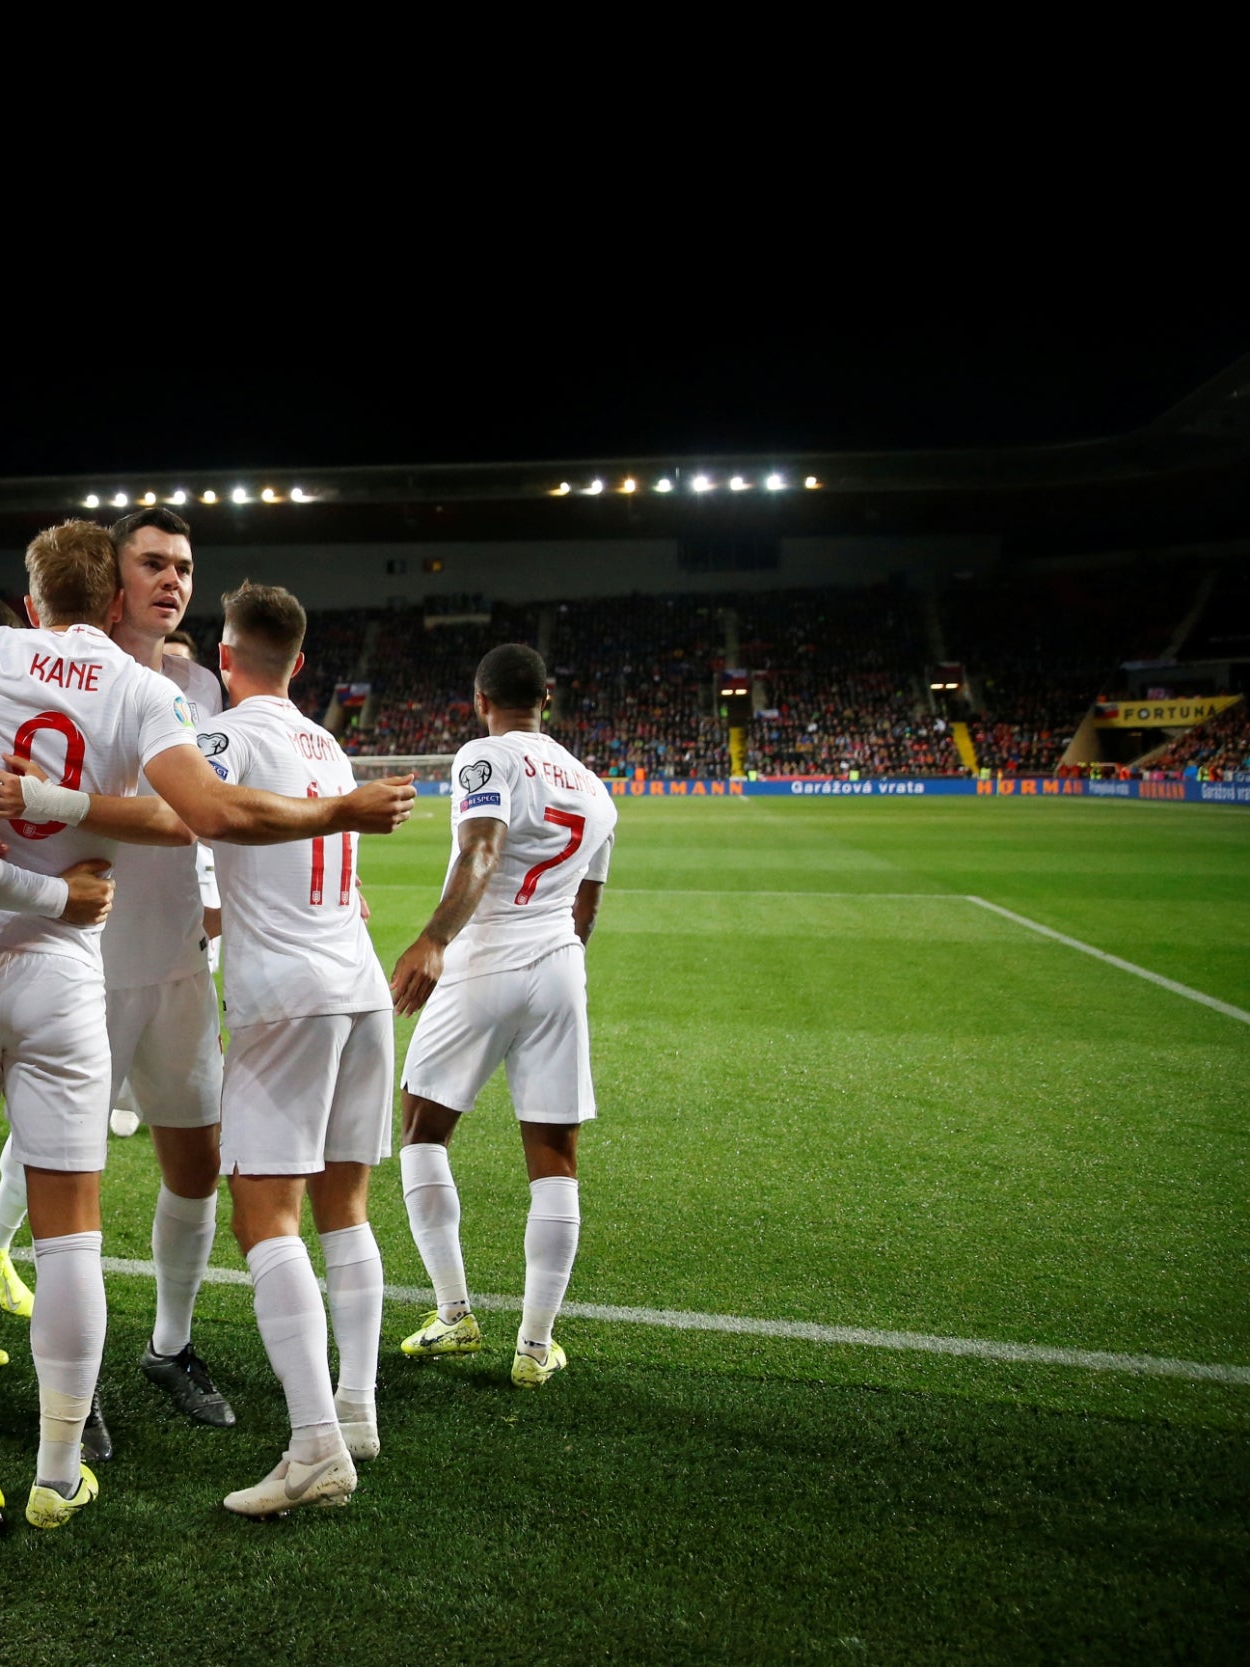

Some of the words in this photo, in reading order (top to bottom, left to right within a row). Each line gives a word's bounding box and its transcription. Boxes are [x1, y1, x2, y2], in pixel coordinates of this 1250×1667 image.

[30, 653, 102, 691] KANE
[1124, 706, 1216, 721] FORTUNA
[286, 732, 340, 761] MOUNT
[523, 755, 596, 796] STERLING
[878, 781, 925, 794] vrata
[468, 796, 499, 805] RESPECT
[305, 782, 354, 906] 11
[514, 806, 586, 905] 7
